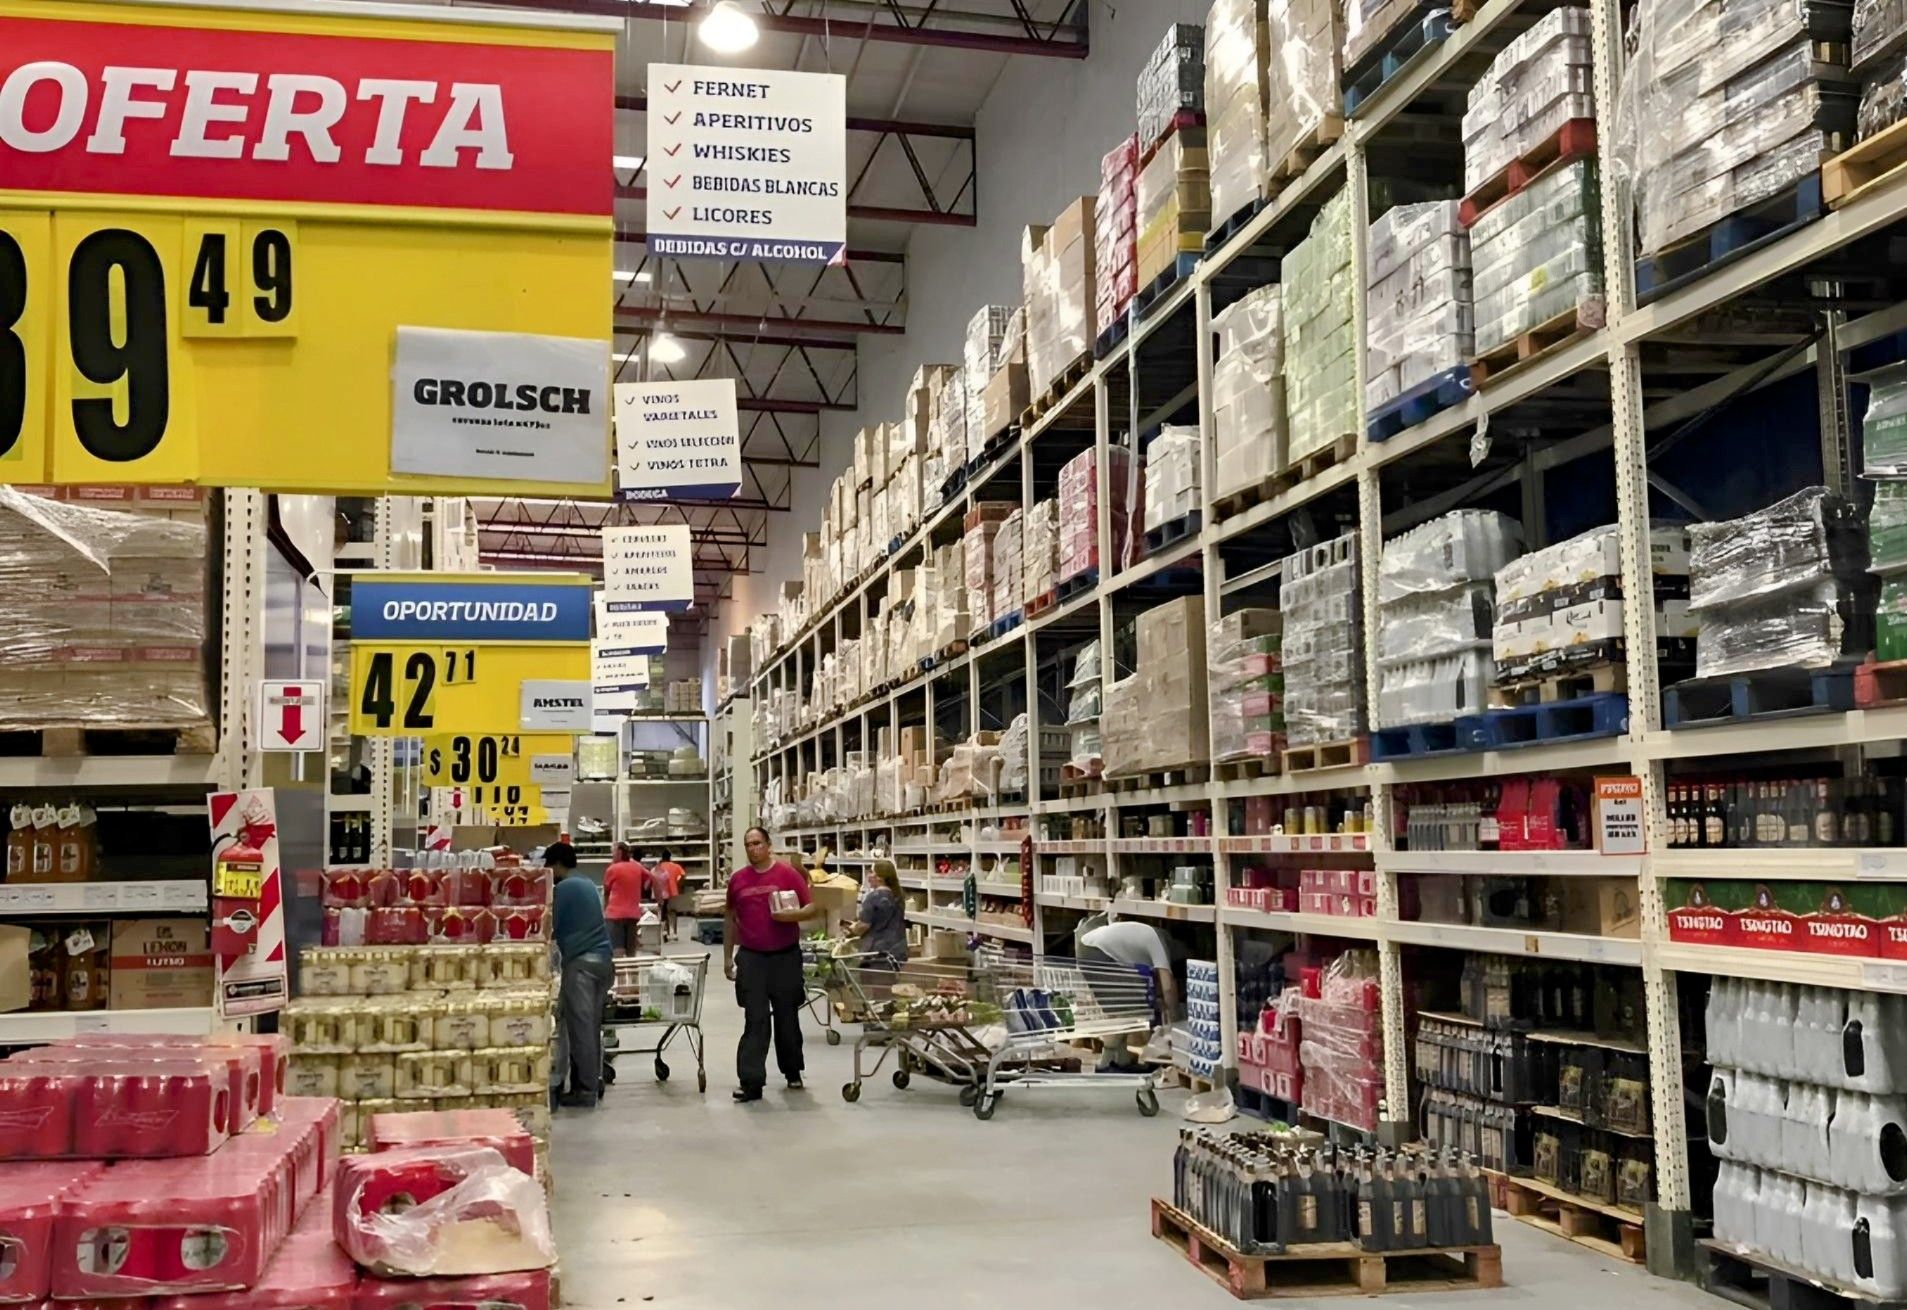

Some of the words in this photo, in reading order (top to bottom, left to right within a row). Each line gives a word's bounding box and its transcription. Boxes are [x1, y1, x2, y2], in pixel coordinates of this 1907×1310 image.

[693, 81, 770, 99] FERNET
[0, 60, 515, 170] OFERTA
[693, 112, 813, 133] APERITIVOS
[693, 143, 791, 163] WHISKIES
[693, 176, 761, 192] BEBIDAS
[765, 179, 839, 197] BLANCAS
[693, 206, 773, 225] LICORES
[752, 243, 828, 260] ALCOHOL
[189, 229, 292, 324] 49
[413, 378, 591, 414] GROLSCH
[383, 600, 557, 622] OPORTUNIDAD
[361, 652, 437, 729] 42
[445, 649, 475, 683] 71
[533, 698, 584, 708] AMSTEL
[451, 736, 497, 783] 30
